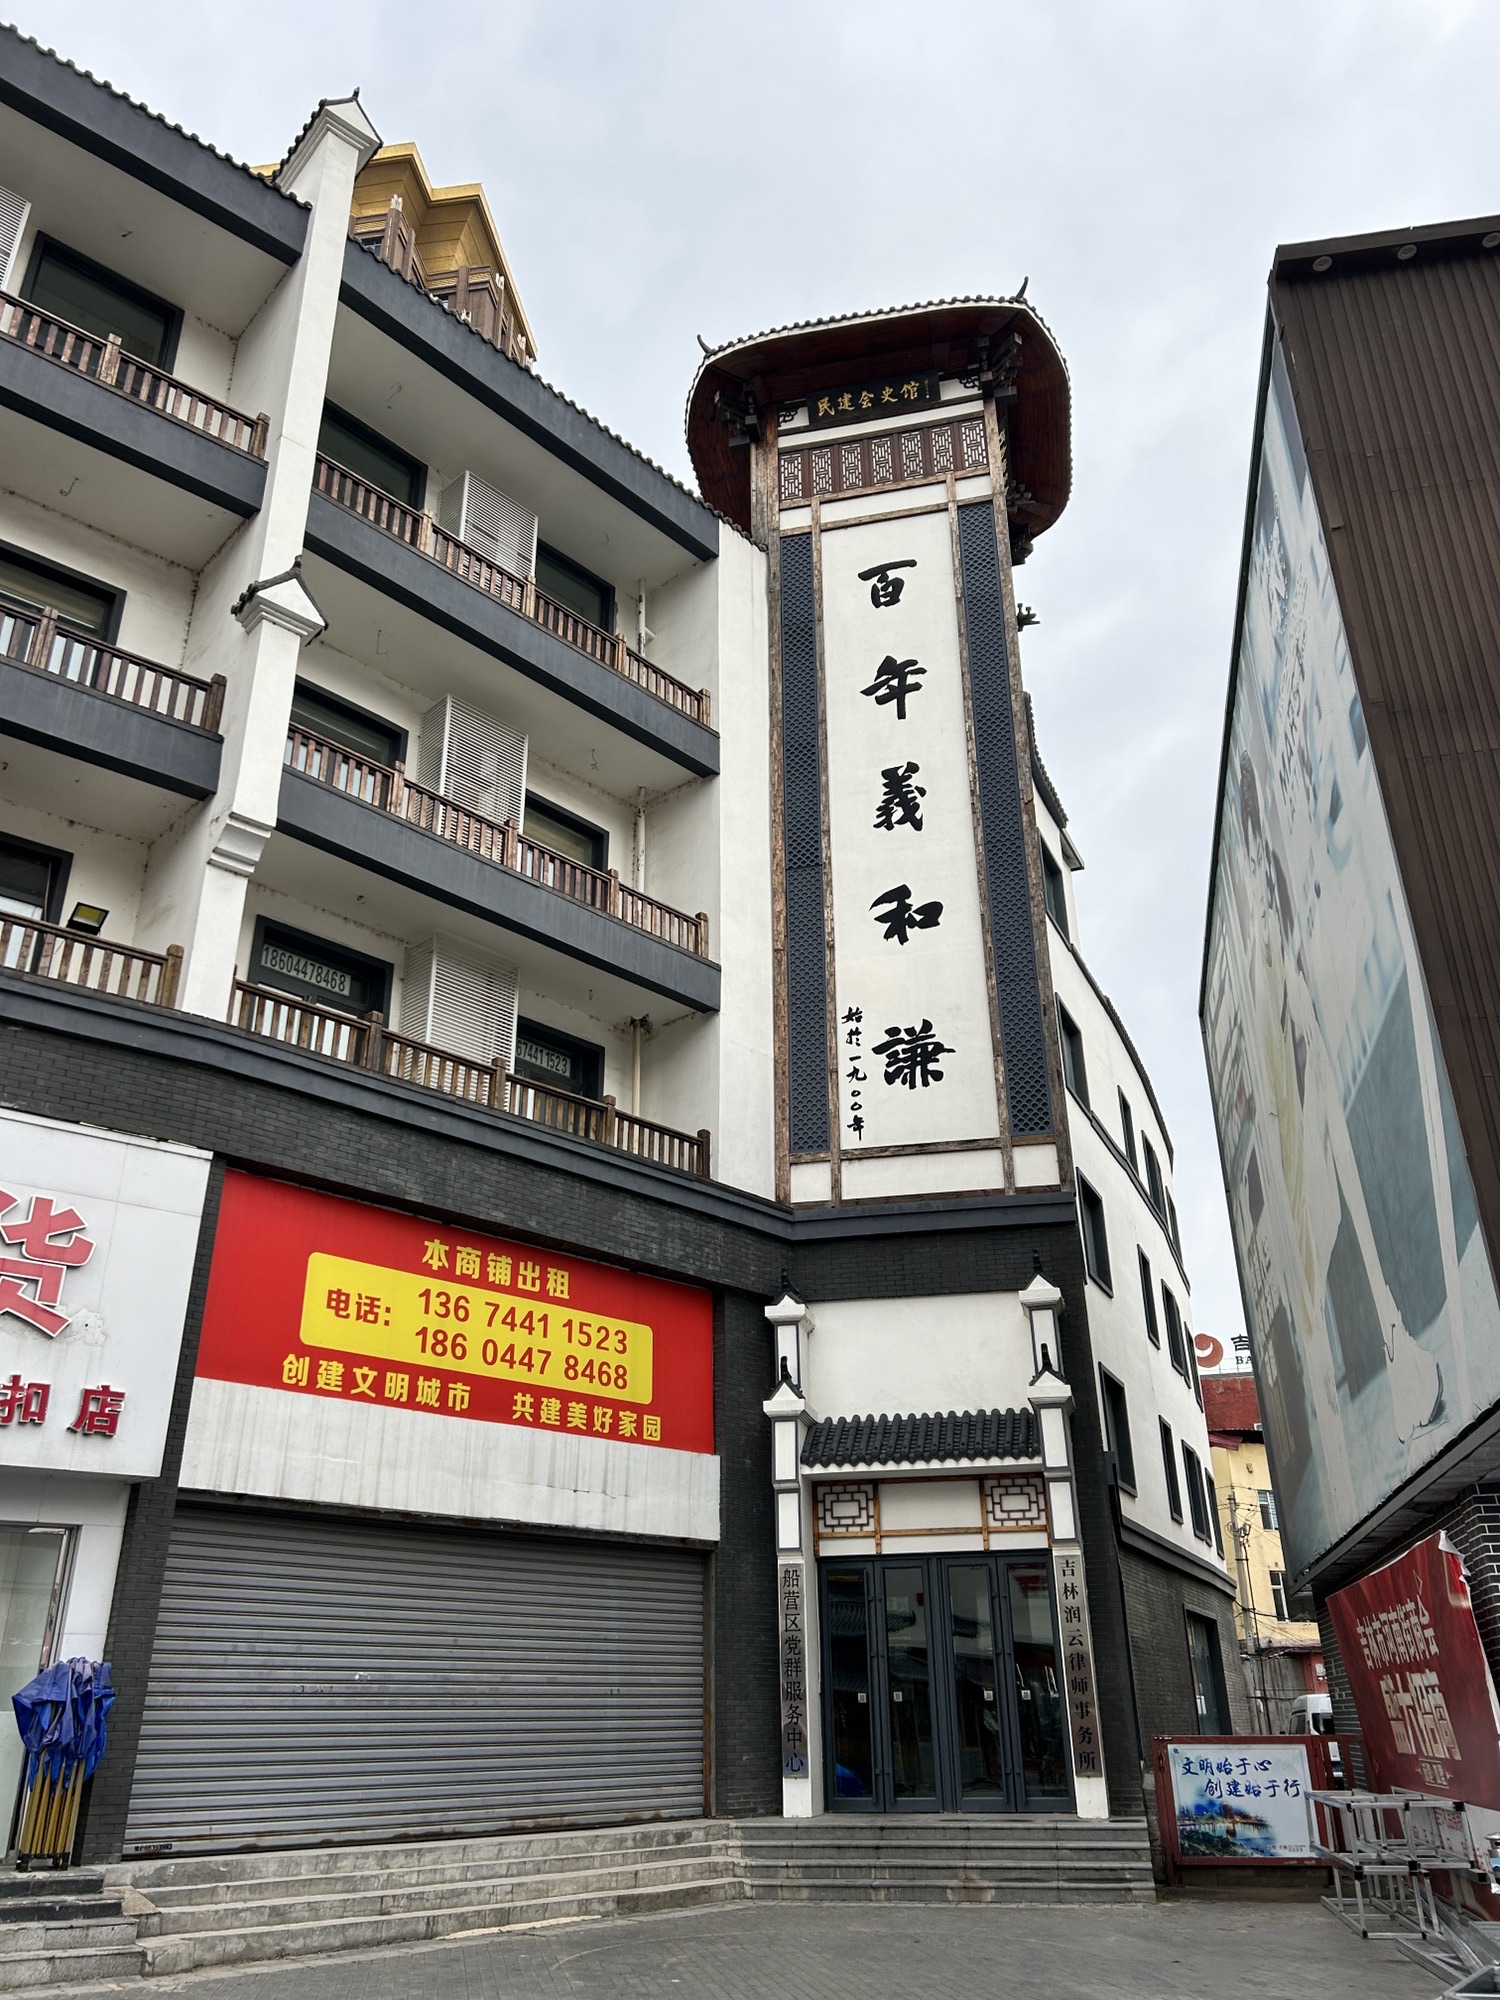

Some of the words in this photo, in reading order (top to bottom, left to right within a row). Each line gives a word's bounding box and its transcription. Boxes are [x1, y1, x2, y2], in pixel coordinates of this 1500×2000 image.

[817, 380, 920, 417] 民建会史馆
[263, 946, 347, 993] 18604478468
[422, 1239, 572, 1300] 本商铺出租
[417, 1287, 471, 1323] 136
[483, 1301, 550, 1339] 7441
[562, 1318, 629, 1355] 1523
[414, 1326, 469, 1361] 186
[481, 1338, 552, 1375] 0447
[563, 1354, 629, 1391] 8468
[281, 1353, 471, 1412] 创建文明城市
[512, 1392, 662, 1442] 共建美好家园
[782, 1567, 804, 1773] 船营区党群服务中心
[1059, 1559, 1097, 1771] 吉林润云律师事务所
[1379, 1667, 1463, 1761] 盛大招商
[1181, 1756, 1273, 1776] 文明始于心
[1204, 1778, 1301, 1799] 创建始于行
